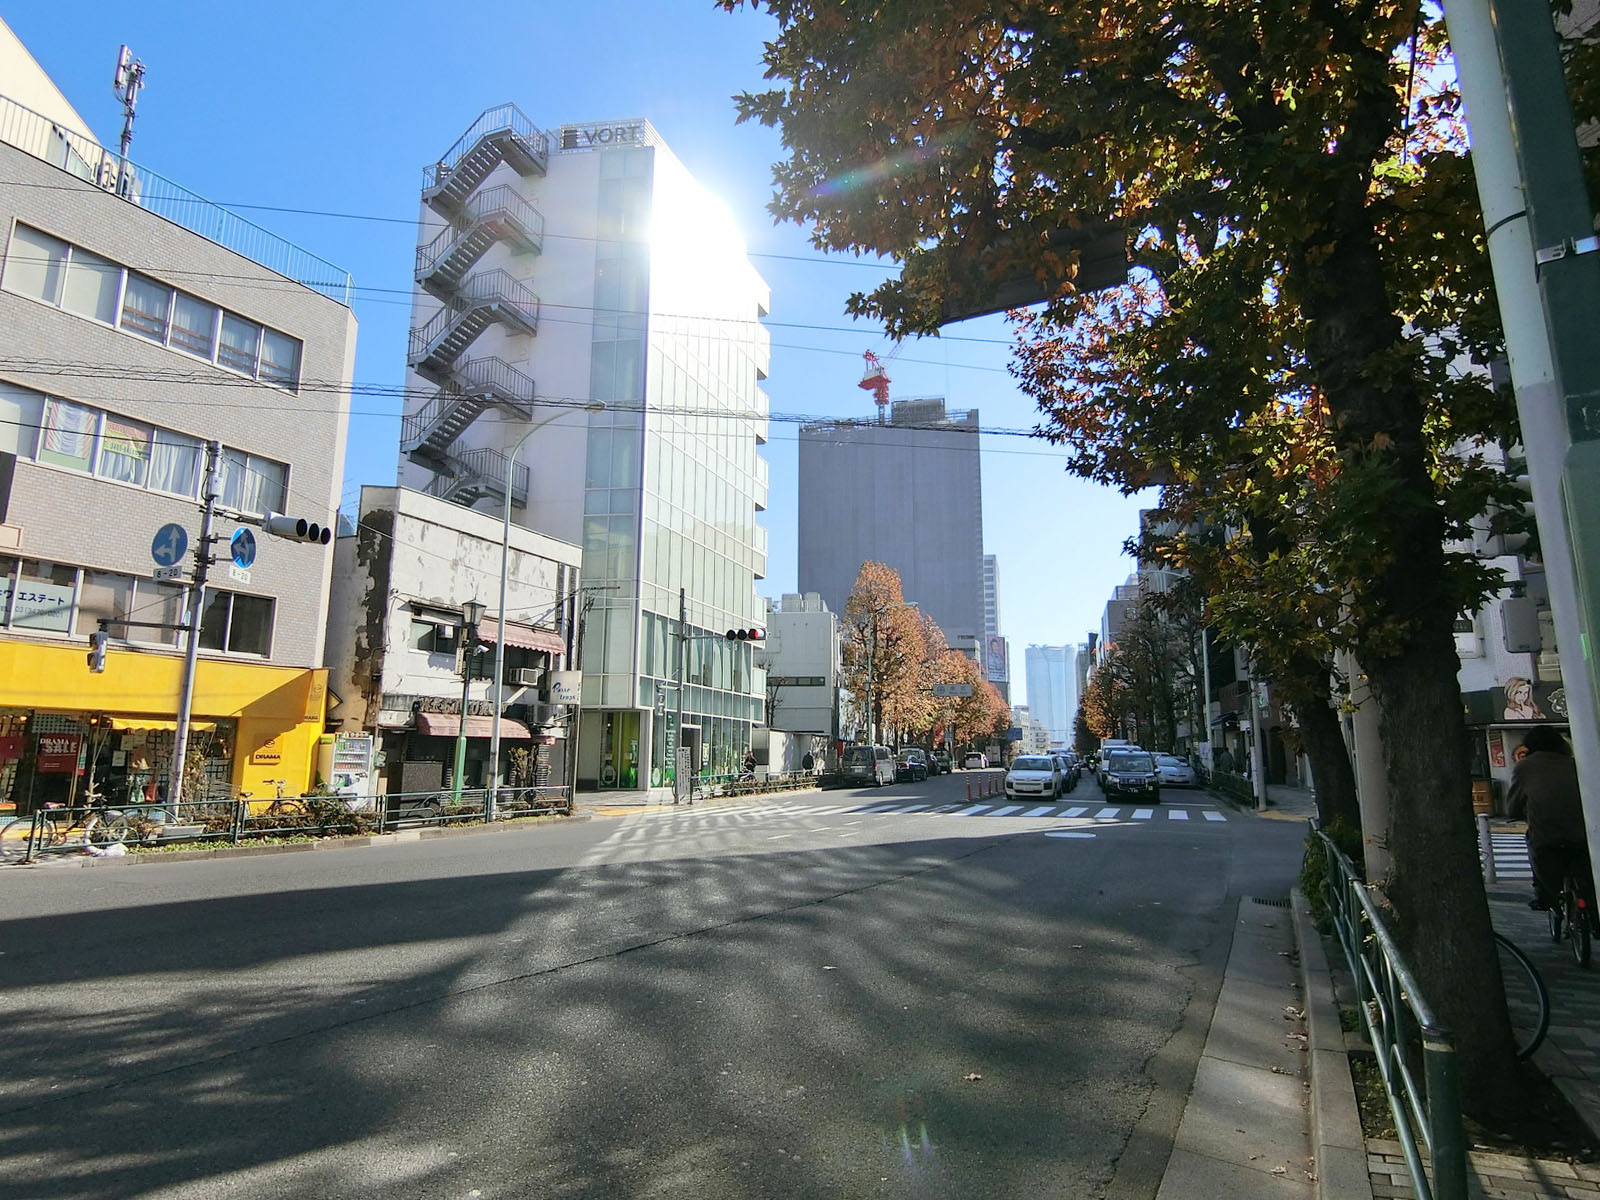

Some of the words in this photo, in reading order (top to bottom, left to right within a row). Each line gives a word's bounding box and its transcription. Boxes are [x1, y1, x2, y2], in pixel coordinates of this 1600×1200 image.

[584, 126, 641, 144] VORT
[156, 568, 178, 578] 8-20
[18, 591, 65, 606] エステート
[40, 737, 70, 745] DRAMA
